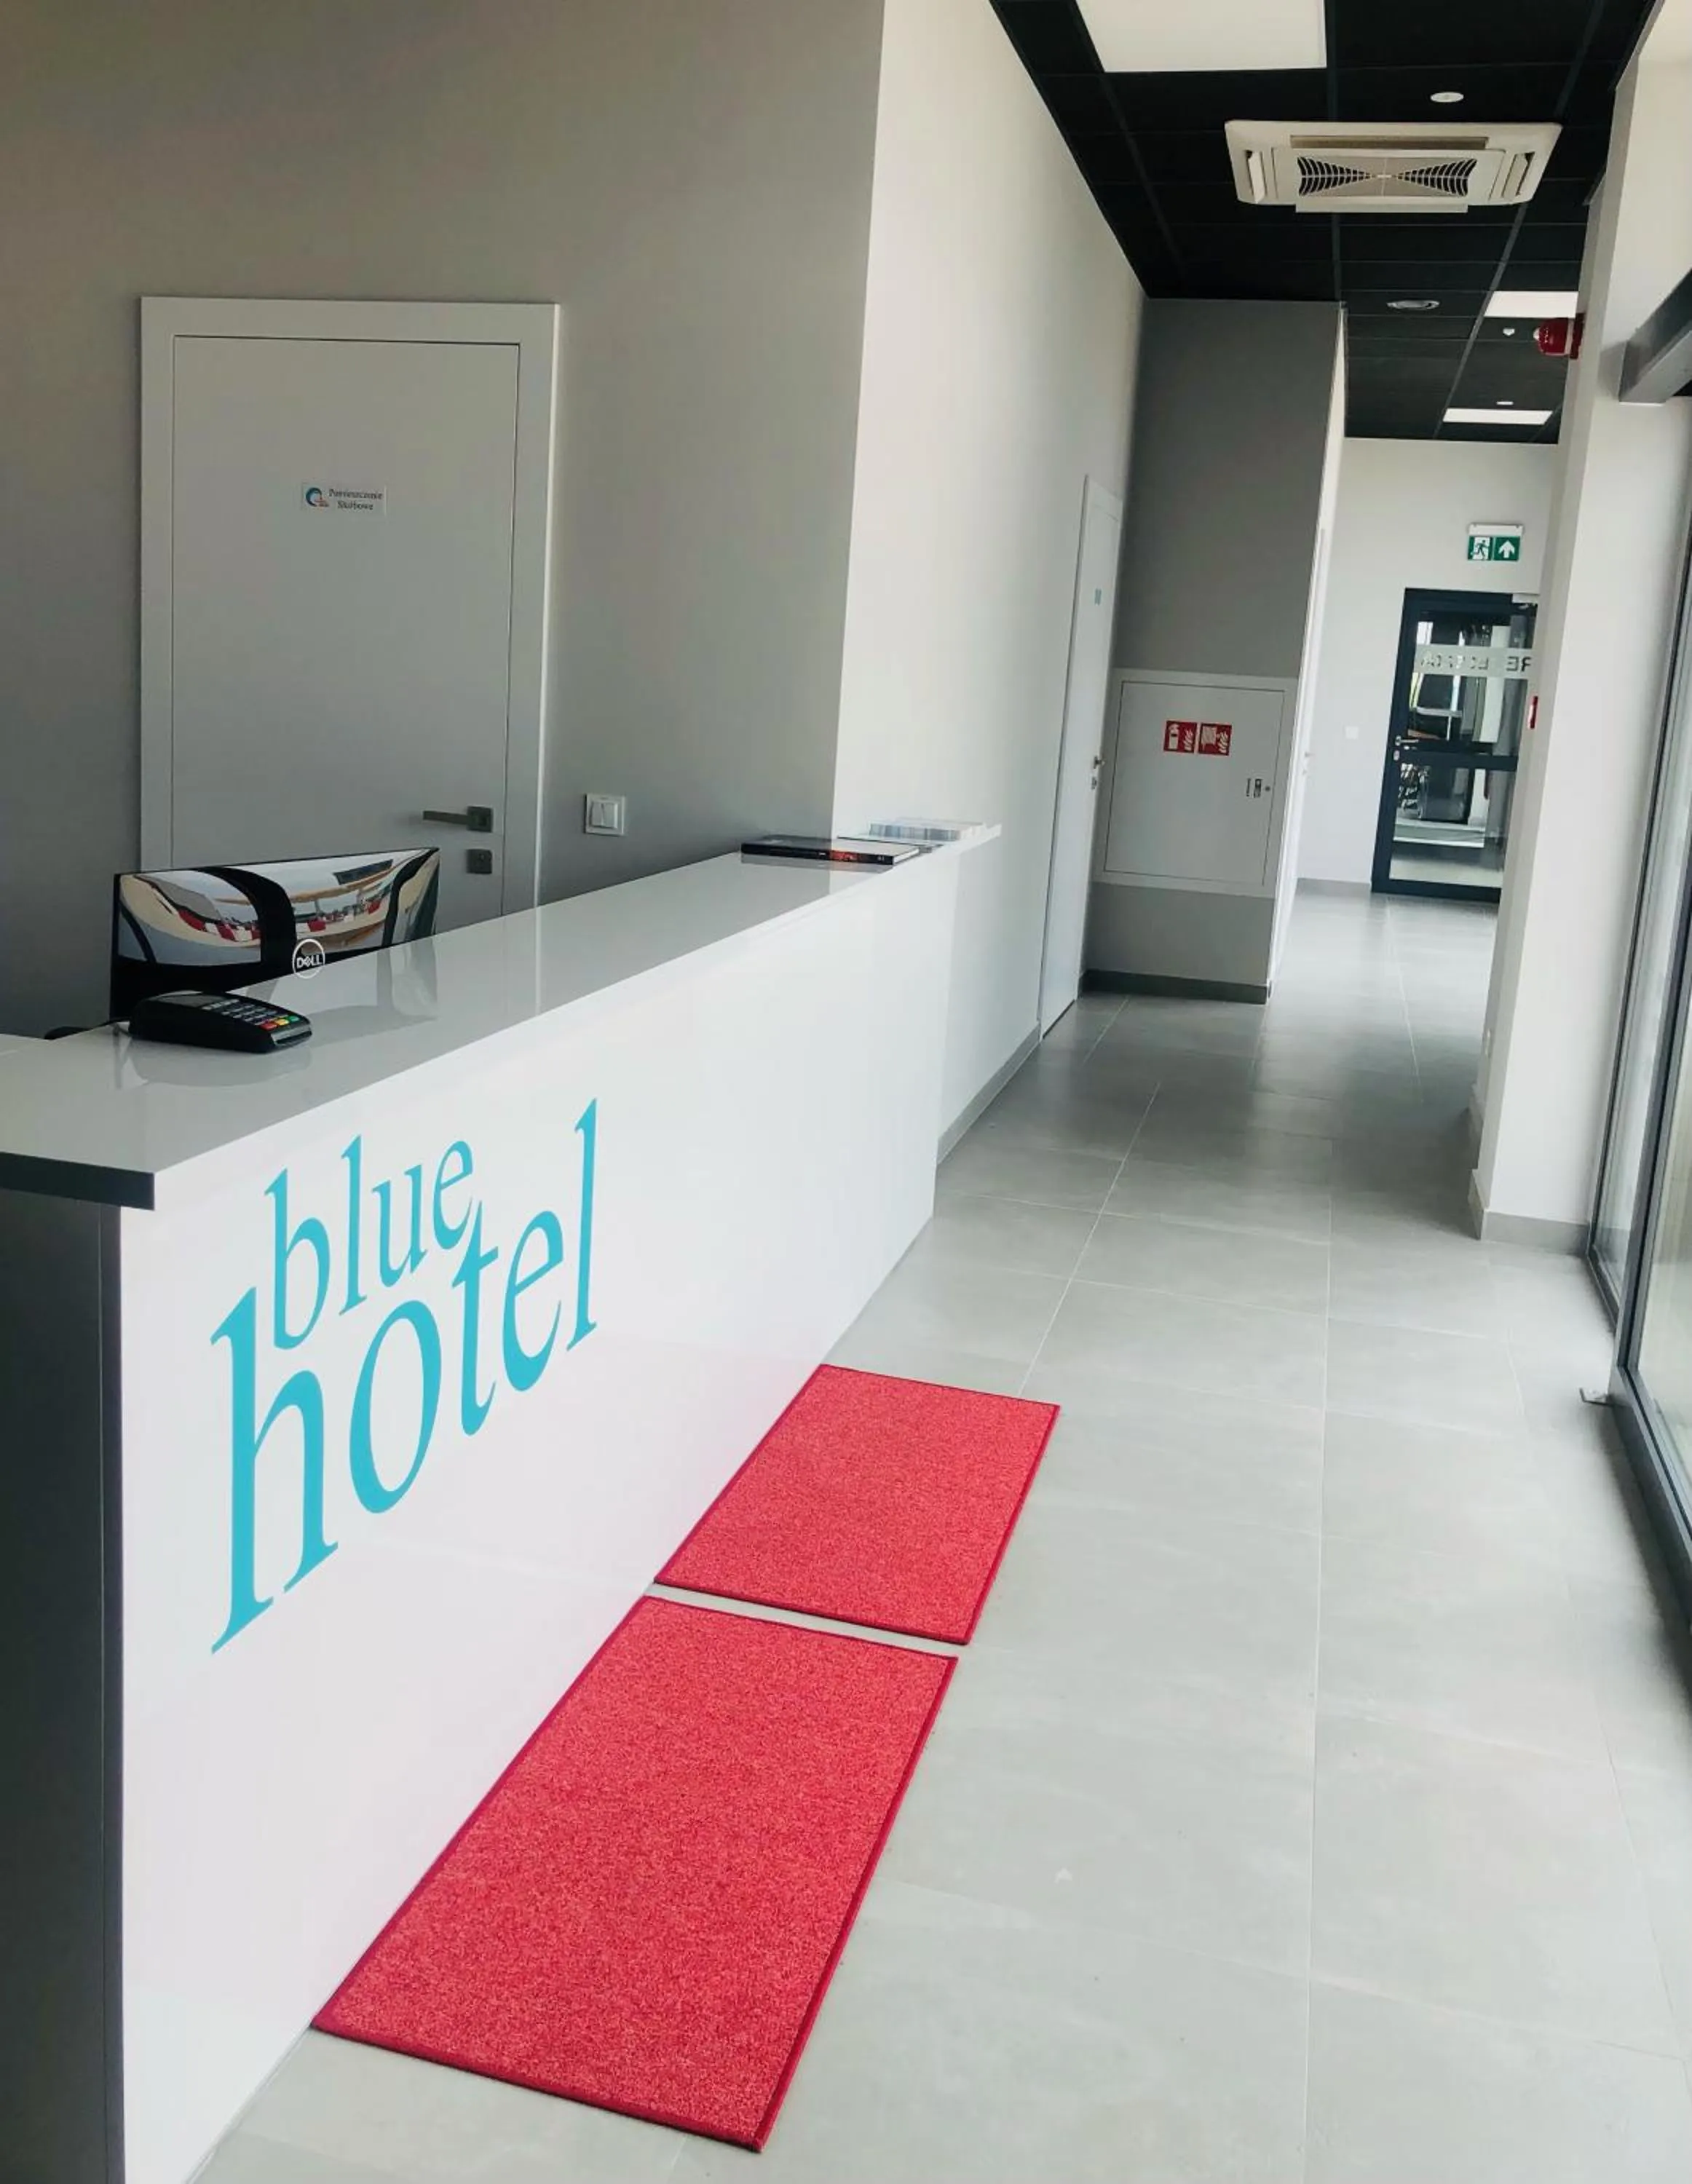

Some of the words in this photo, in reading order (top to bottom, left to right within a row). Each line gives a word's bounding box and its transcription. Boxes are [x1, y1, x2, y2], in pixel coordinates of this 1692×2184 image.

[296, 954, 322, 969] DELL
[265, 1135, 473, 1350] blue
[210, 1099, 597, 1653] hotel
